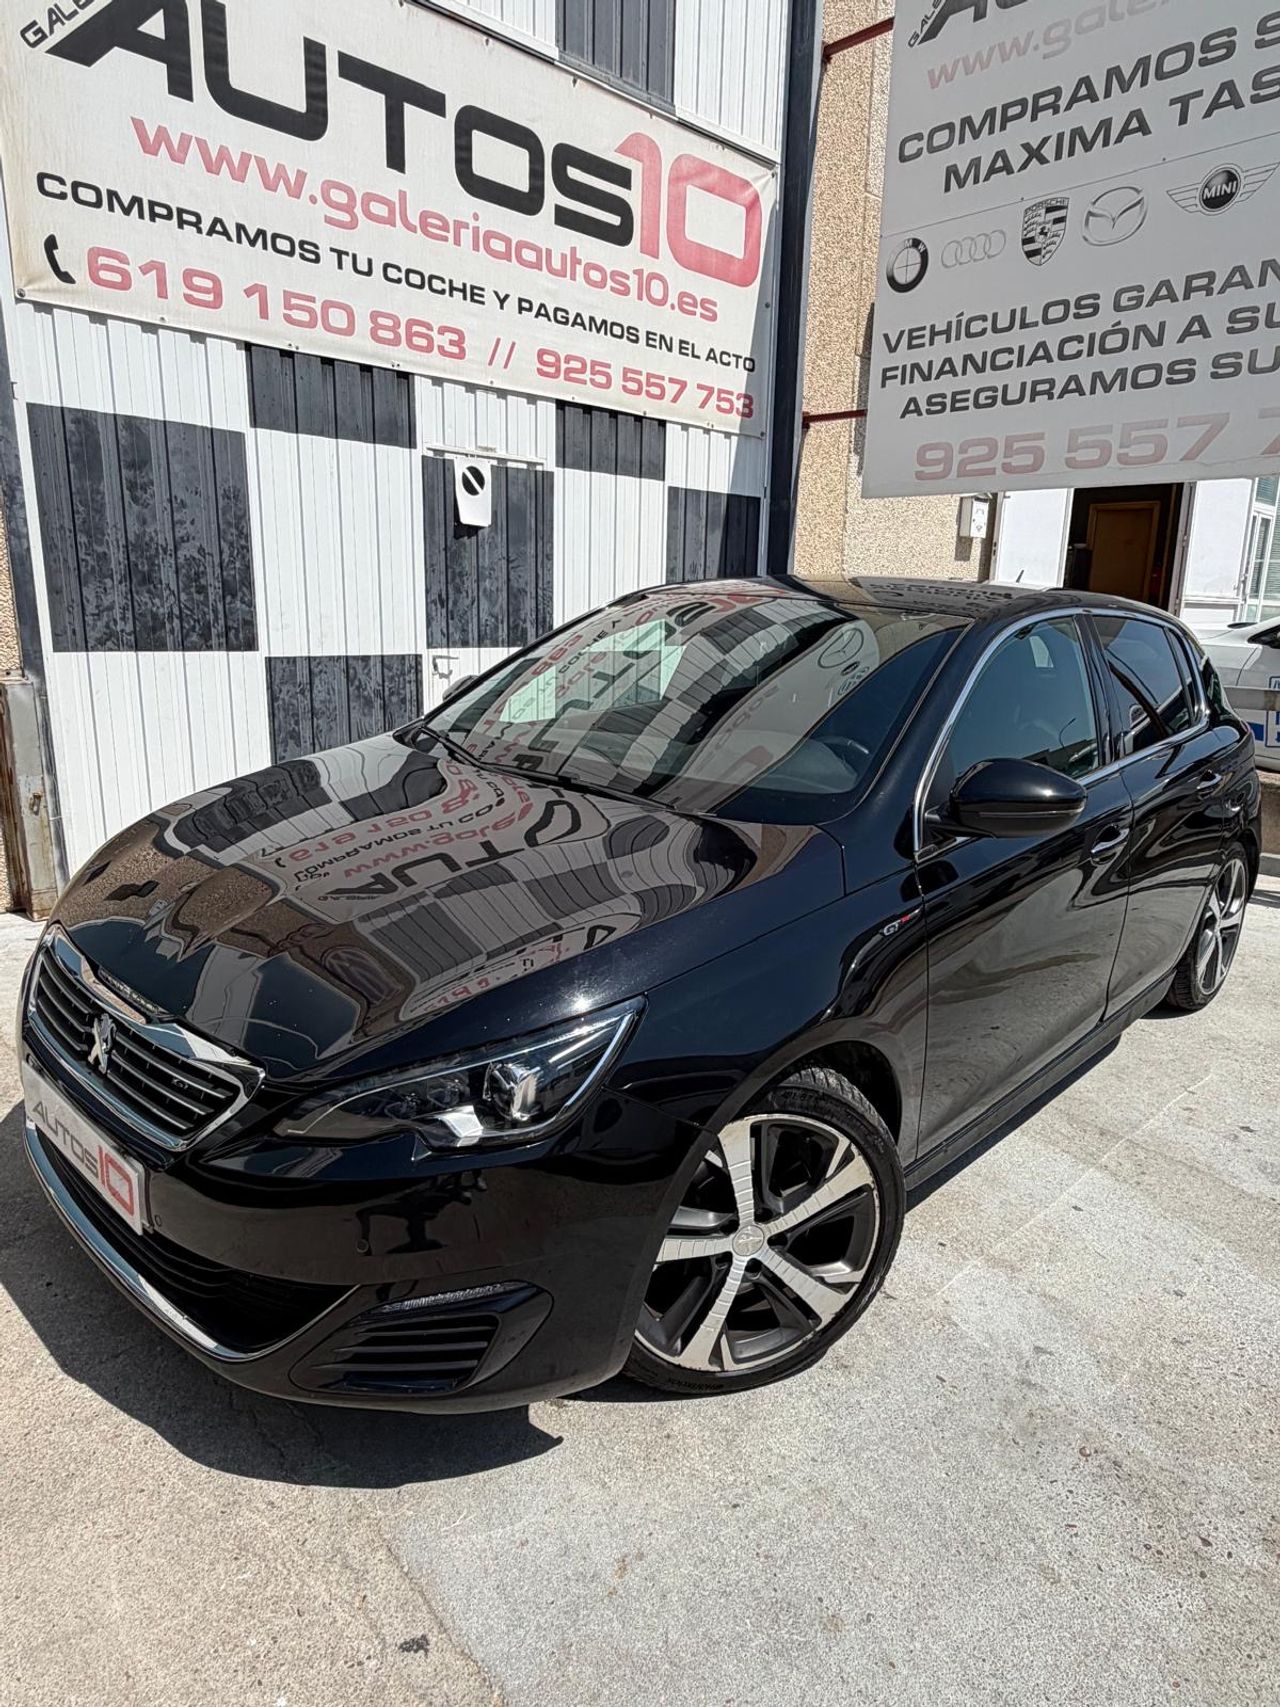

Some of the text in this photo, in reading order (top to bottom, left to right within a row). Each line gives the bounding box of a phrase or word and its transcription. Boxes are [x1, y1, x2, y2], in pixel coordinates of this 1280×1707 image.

[898, 27, 1238, 164] COMPRAMOS
[927, 0, 1170, 90] www.gale
[44, 0, 762, 288] AUTOS10
[943, 64, 1280, 194] MAXIMA TAS
[131, 116, 719, 323] www.galeriaautos10.es
[1202, 180, 1238, 201] MINI
[36, 172, 756, 373] COMPRAMOS TU COCHE Y PAGAMOS EN EL ACTO
[883, 258, 1280, 354] VEHÍCULOS GARAN
[87, 246, 224, 310] 619
[243, 282, 356, 337] 150
[369, 309, 467, 361] 863
[536, 347, 613, 390] 925
[621, 370, 688, 403] 557
[696, 383, 754, 419] 753
[880, 320, 1167, 388] FINANCIACIÓN
[1176, 314, 1212, 344] A
[900, 346, 1280, 419] ASEGURAMOS SU
[915, 432, 1046, 481] 925
[1065, 412, 1231, 470] 557
[32, 1101, 134, 1217] AUTOS10
